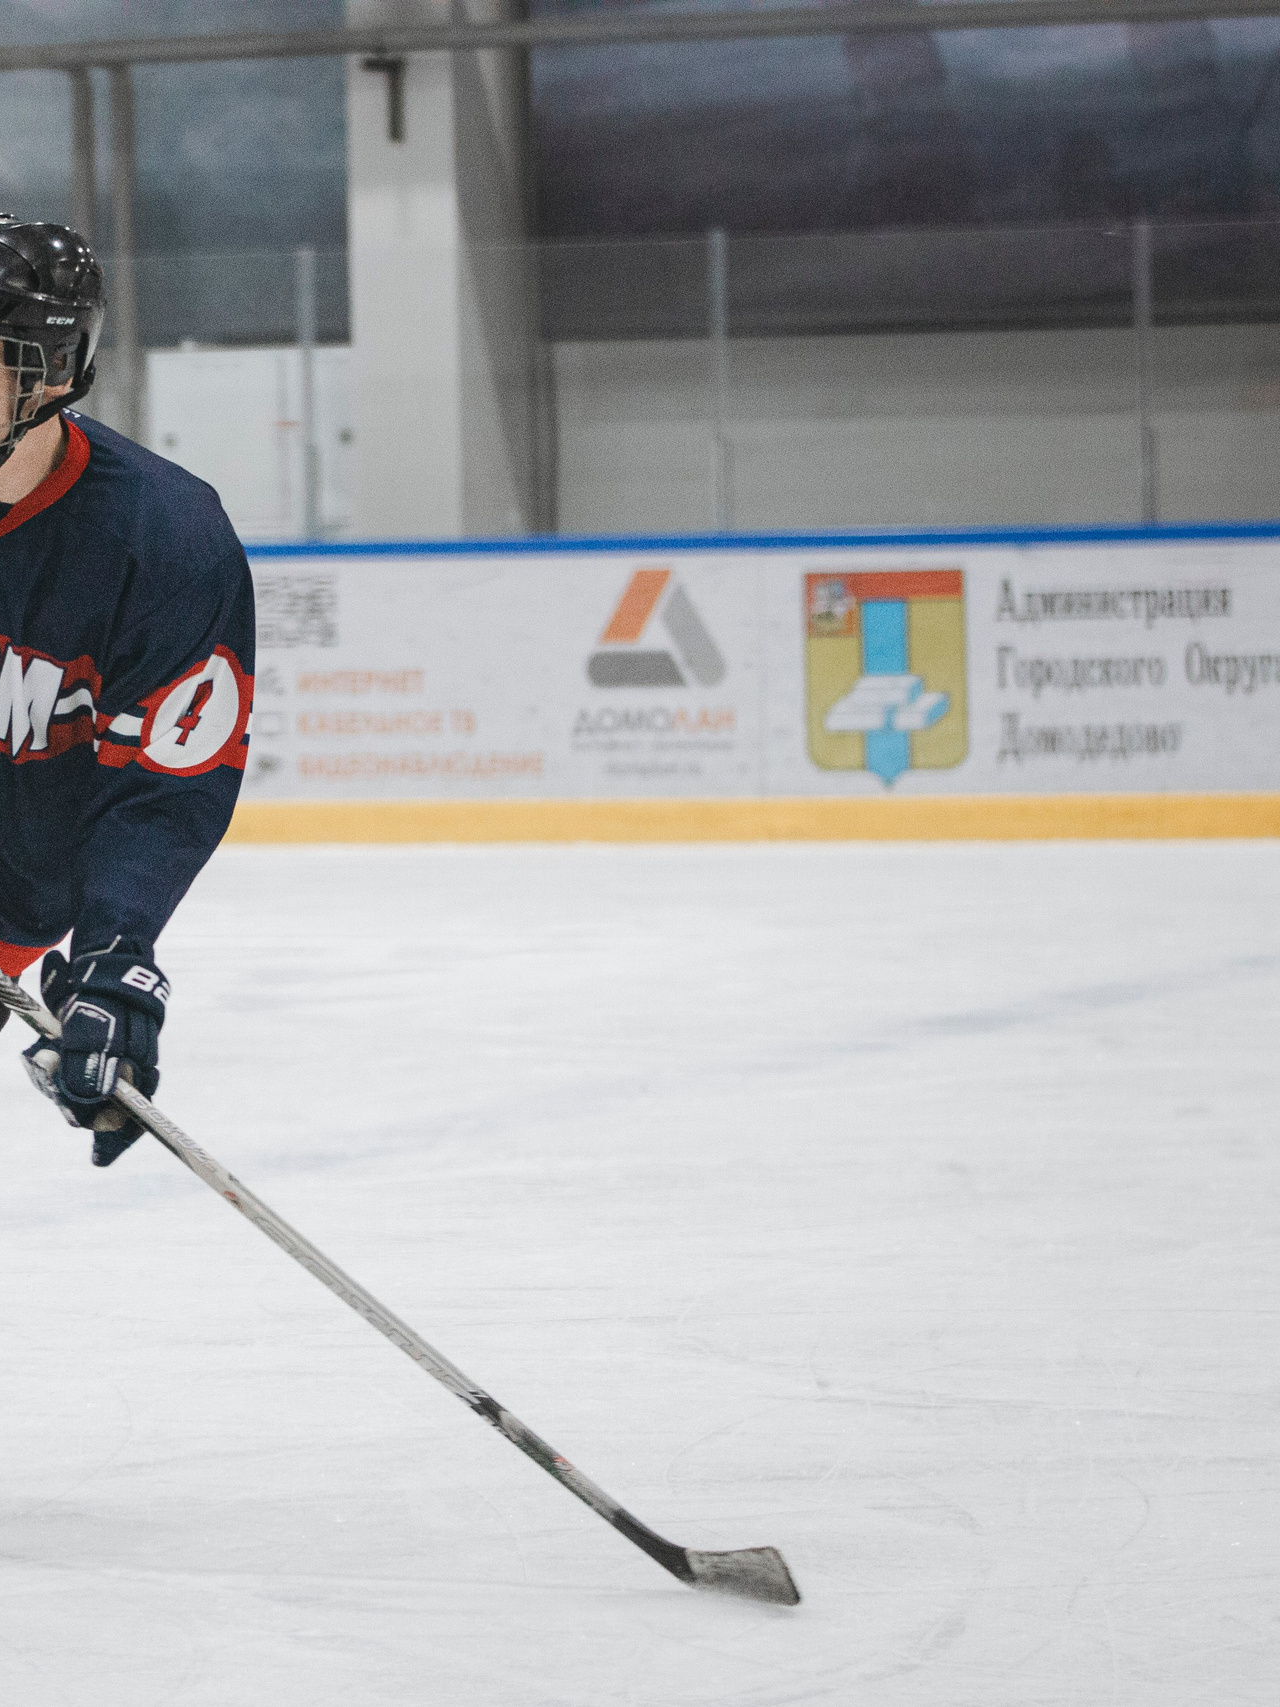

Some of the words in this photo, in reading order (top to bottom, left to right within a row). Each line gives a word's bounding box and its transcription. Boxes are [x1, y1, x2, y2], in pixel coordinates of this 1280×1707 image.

[994, 577, 1232, 630] Администрация
[996, 645, 1167, 699] Городского
[996, 712, 1183, 766] Домодедово
